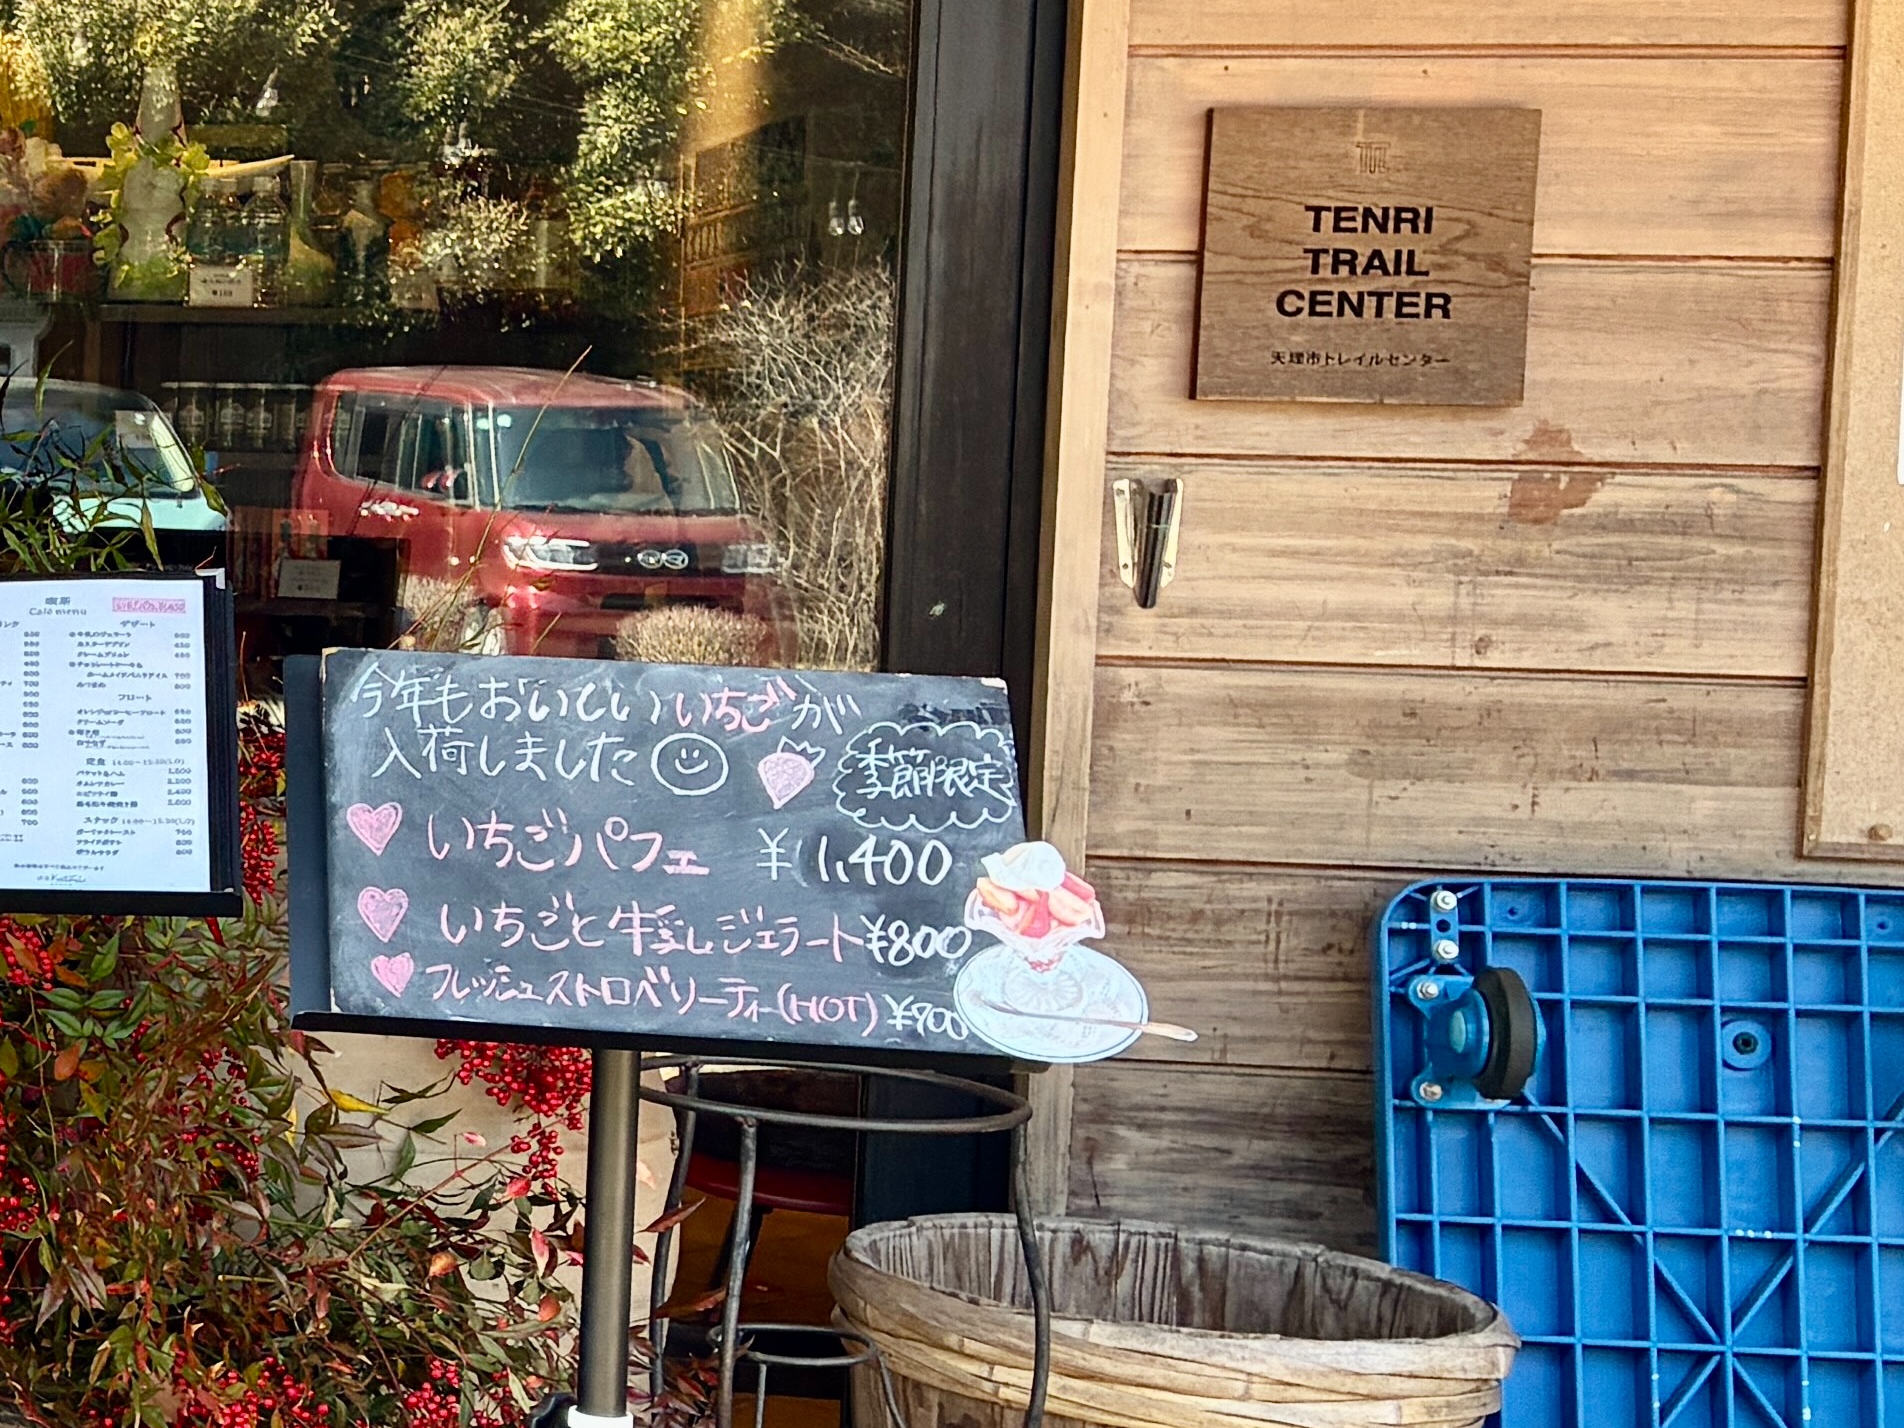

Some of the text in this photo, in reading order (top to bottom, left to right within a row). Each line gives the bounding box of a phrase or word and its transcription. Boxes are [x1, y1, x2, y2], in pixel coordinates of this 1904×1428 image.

[1304, 205, 1434, 235] TENRI
[1303, 248, 1430, 278] TRAIL
[1275, 289, 1452, 320] CENTER
[1270, 350, 1451, 367] 天理市トレイルセンター
[350, 661, 862, 735] 今年もおいしいいちごが
[371, 723, 638, 787] 入荷しました
[855, 737, 1016, 806] 季節限定
[427, 808, 954, 887] いちごパフェ ¥1,400
[440, 891, 972, 967] いちごと牛乳ジェラート ¥800
[881, 993, 970, 1041] ¥900
